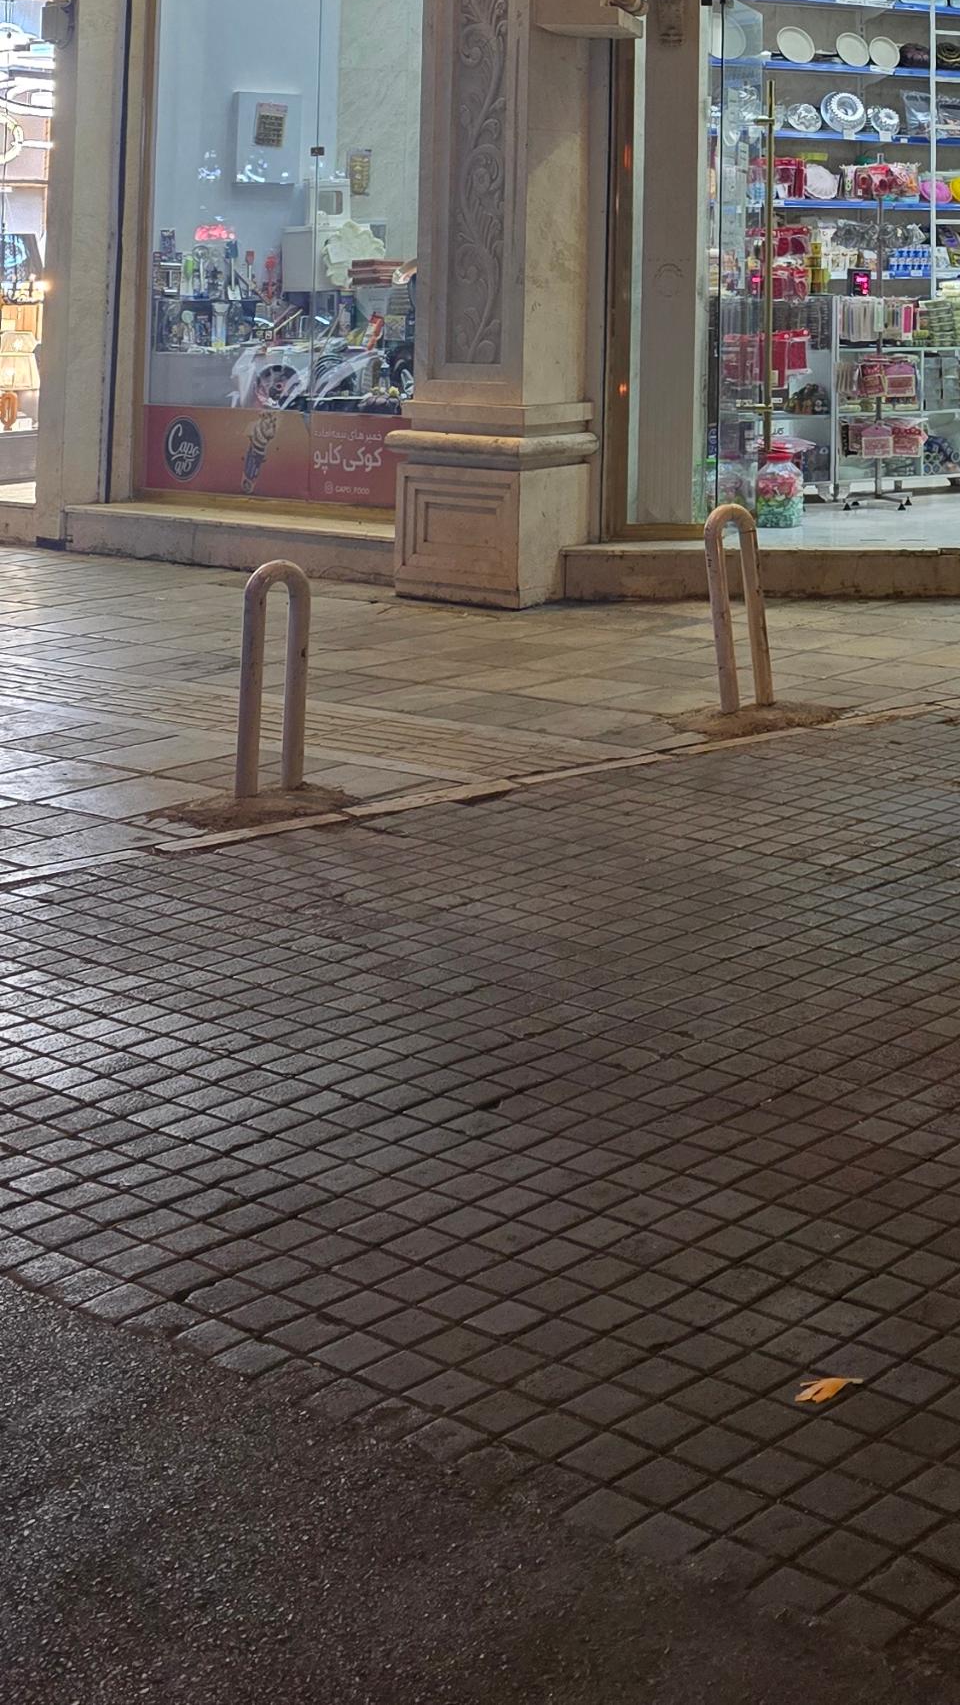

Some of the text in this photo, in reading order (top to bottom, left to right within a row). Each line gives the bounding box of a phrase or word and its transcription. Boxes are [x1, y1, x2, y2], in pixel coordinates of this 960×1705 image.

[168, 423, 200, 456] Capo
[313, 442, 384, 475] کوکی کاپو
